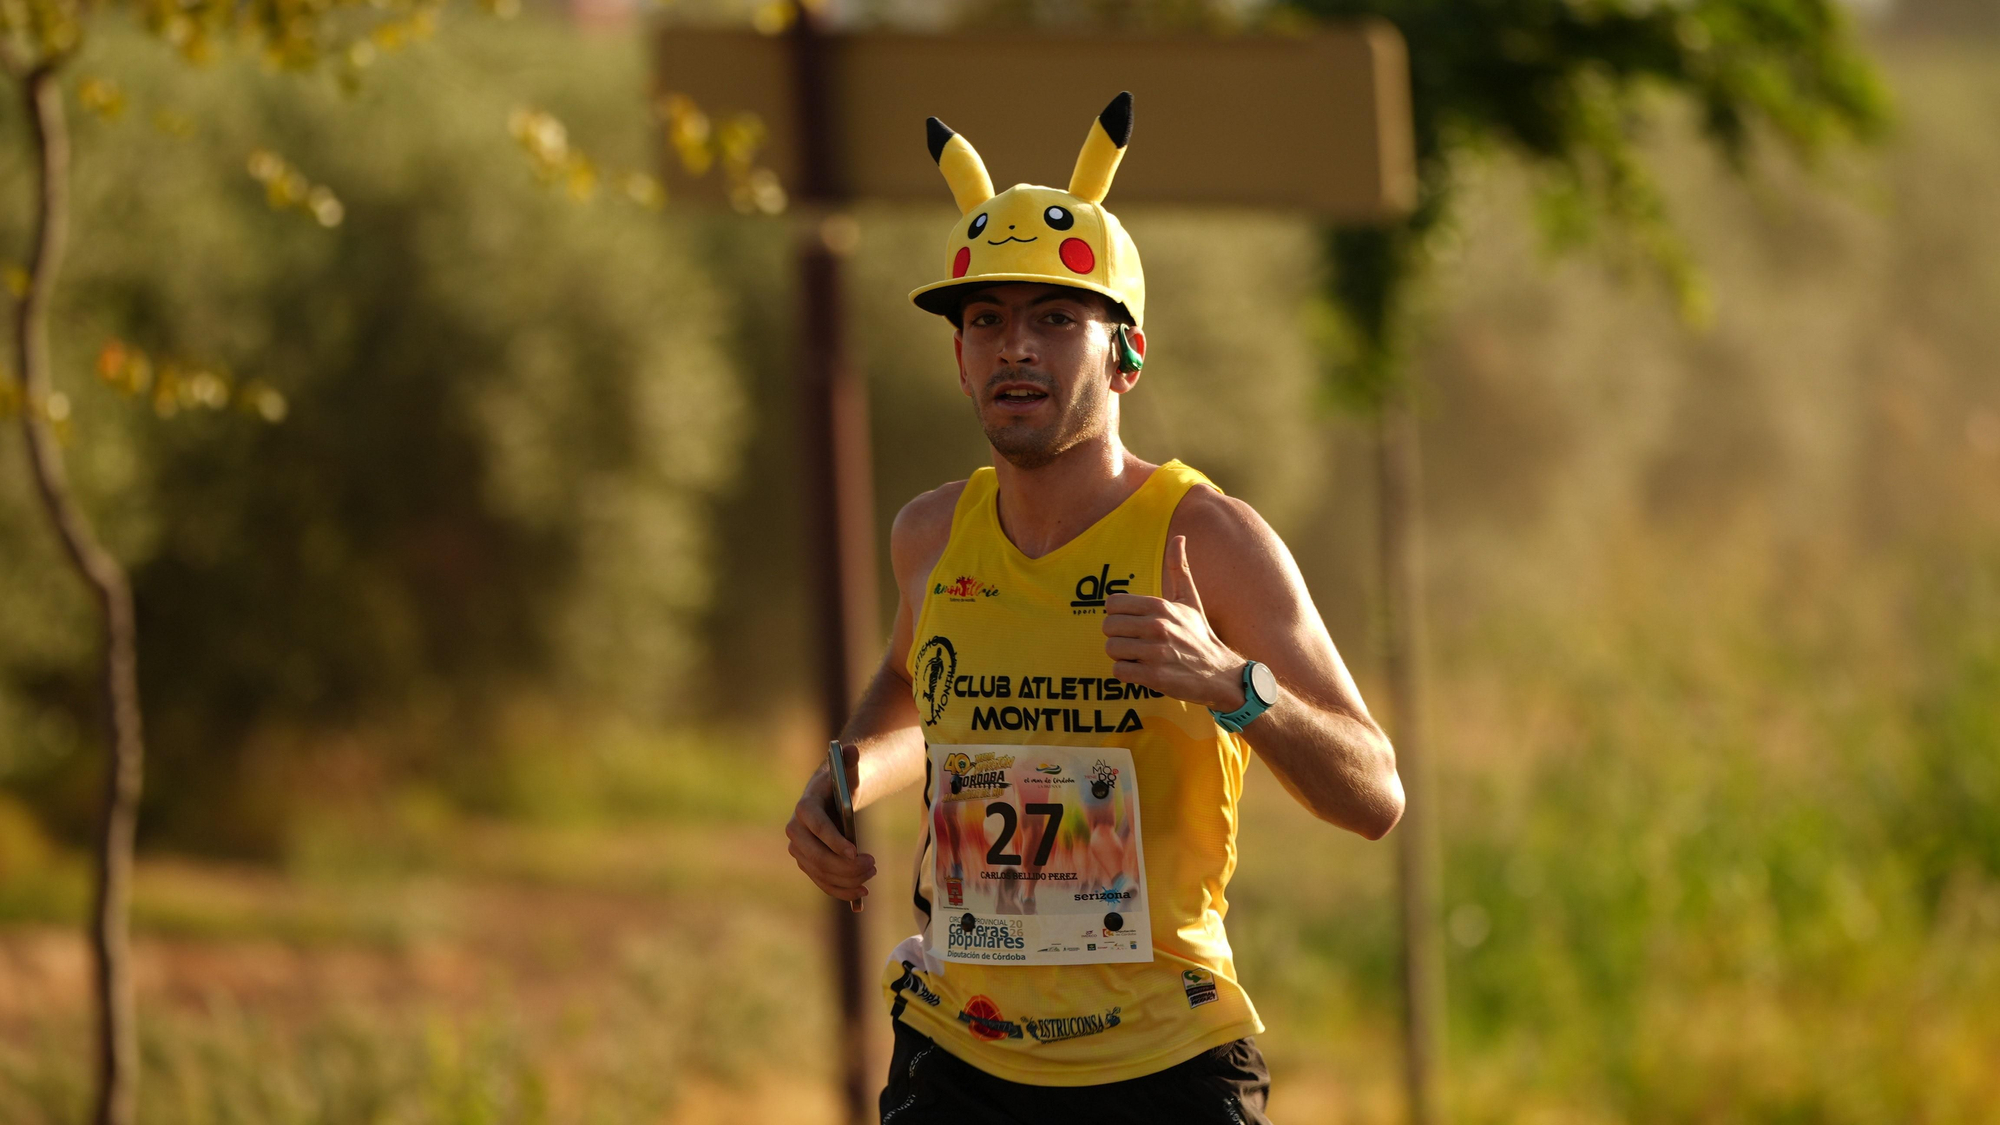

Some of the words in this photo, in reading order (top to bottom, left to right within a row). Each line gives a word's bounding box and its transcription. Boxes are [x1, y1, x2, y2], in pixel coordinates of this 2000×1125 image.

[954, 675, 1011, 698] CLUB
[971, 706, 1144, 733] MONTILLA
[960, 771, 1005, 787] ORDOBA
[986, 801, 1064, 866] 27
[980, 872, 1011, 880] CARLOS
[1013, 872, 1047, 880] BELLIDO
[1074, 890, 1131, 900] serizona
[1009, 920, 1023, 928] 20
[1009, 928, 1024, 937] 26
[948, 933, 1025, 950] populares
[947, 950, 980, 959] Diputación
[982, 952, 991, 960] de
[992, 952, 1026, 960] Córdoba
[1038, 1014, 1104, 1038] ESTRUCONSA
